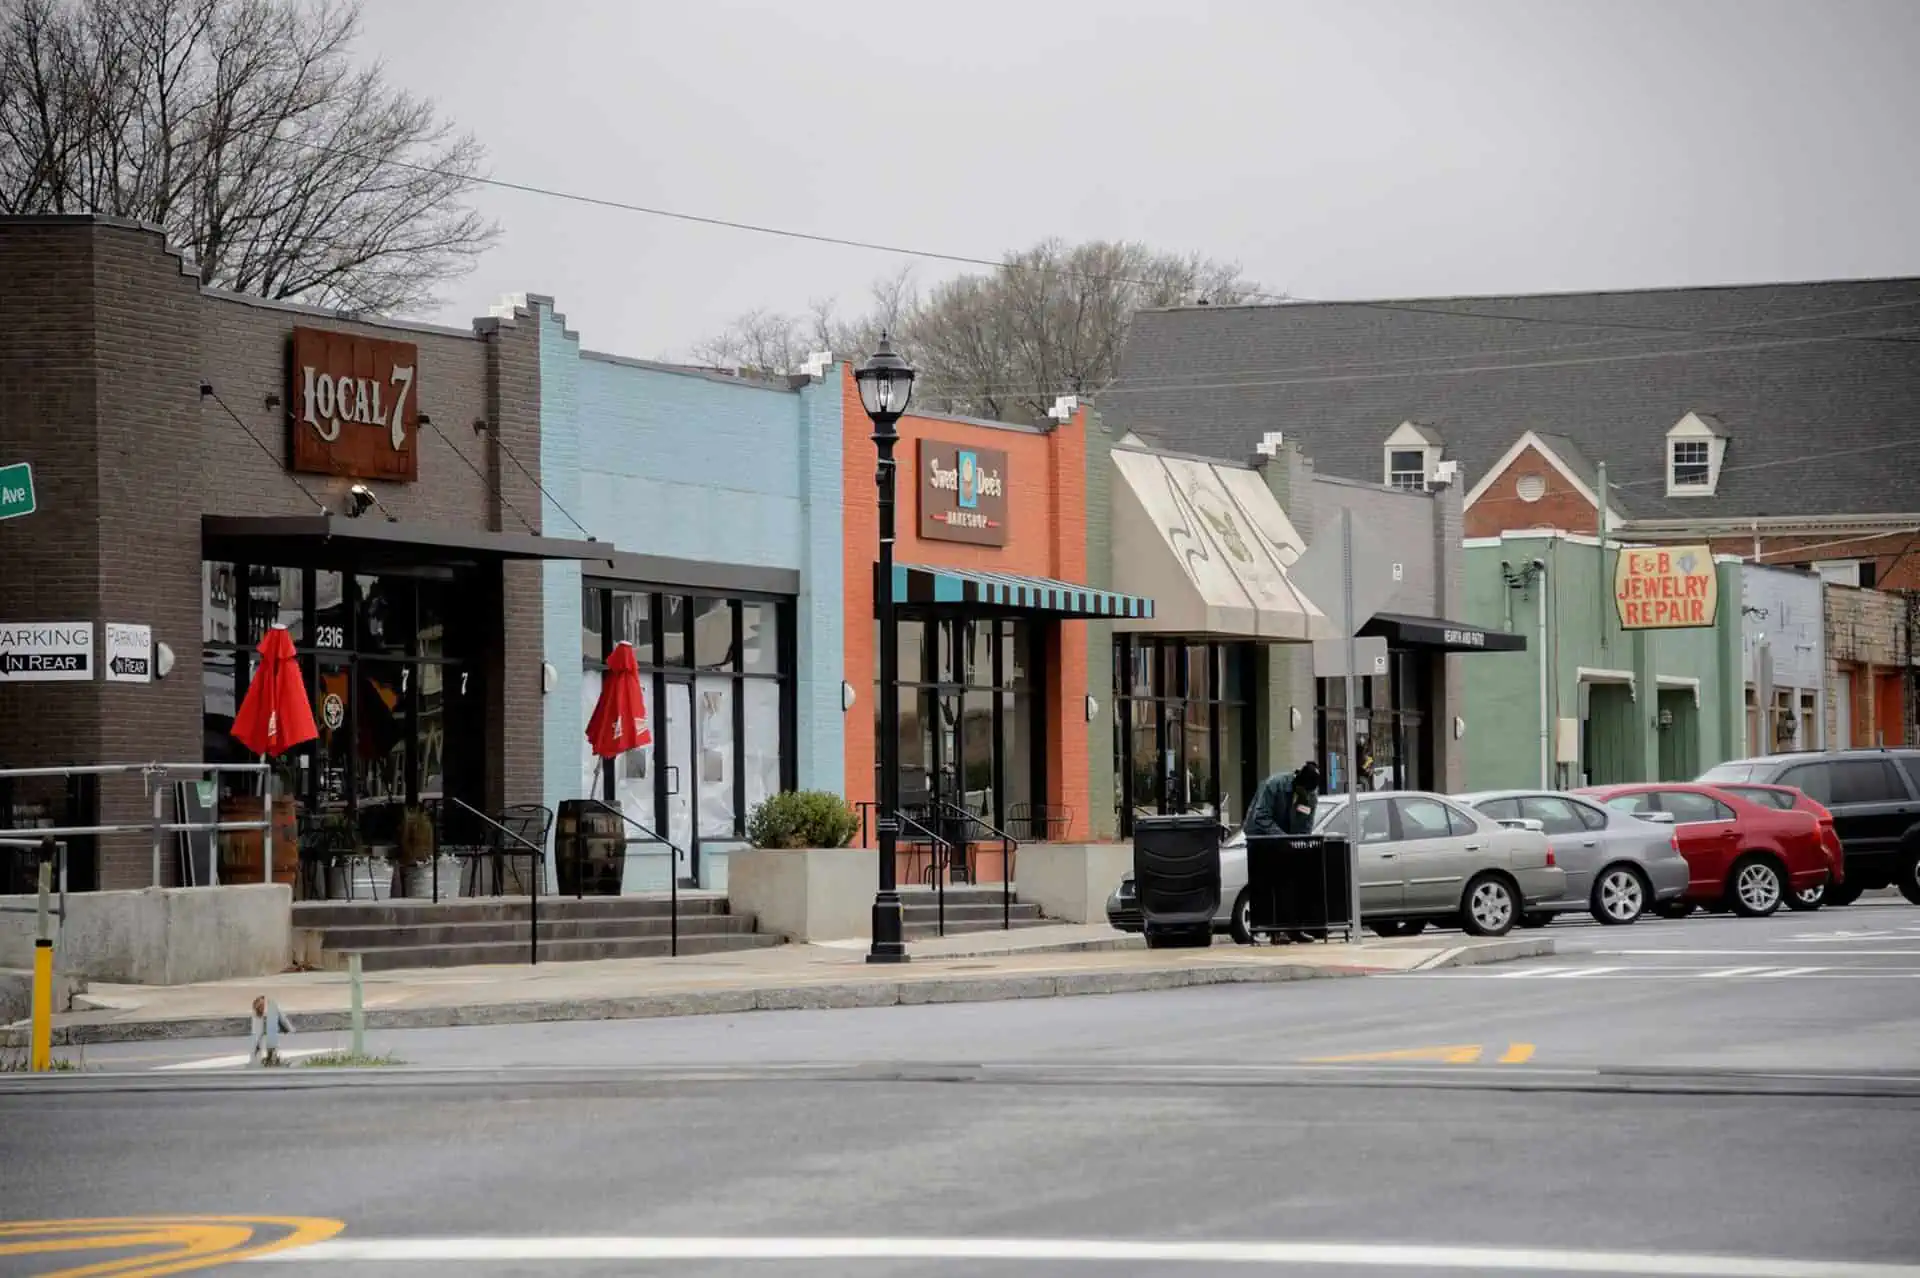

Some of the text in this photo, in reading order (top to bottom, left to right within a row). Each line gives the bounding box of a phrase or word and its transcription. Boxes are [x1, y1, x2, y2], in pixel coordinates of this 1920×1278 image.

[303, 363, 415, 451] LOCAL 7
[2, 486, 25, 504] Ave
[1618, 575, 1709, 600] JEWELRY
[1624, 598, 1705, 625] REPAIR
[0, 629, 89, 647] ARKING
[316, 626, 344, 649] 2316
[6, 655, 77, 670] IN REAR
[124, 657, 145, 674] REAR
[401, 668, 410, 693] 7
[461, 671, 469, 696] 7
